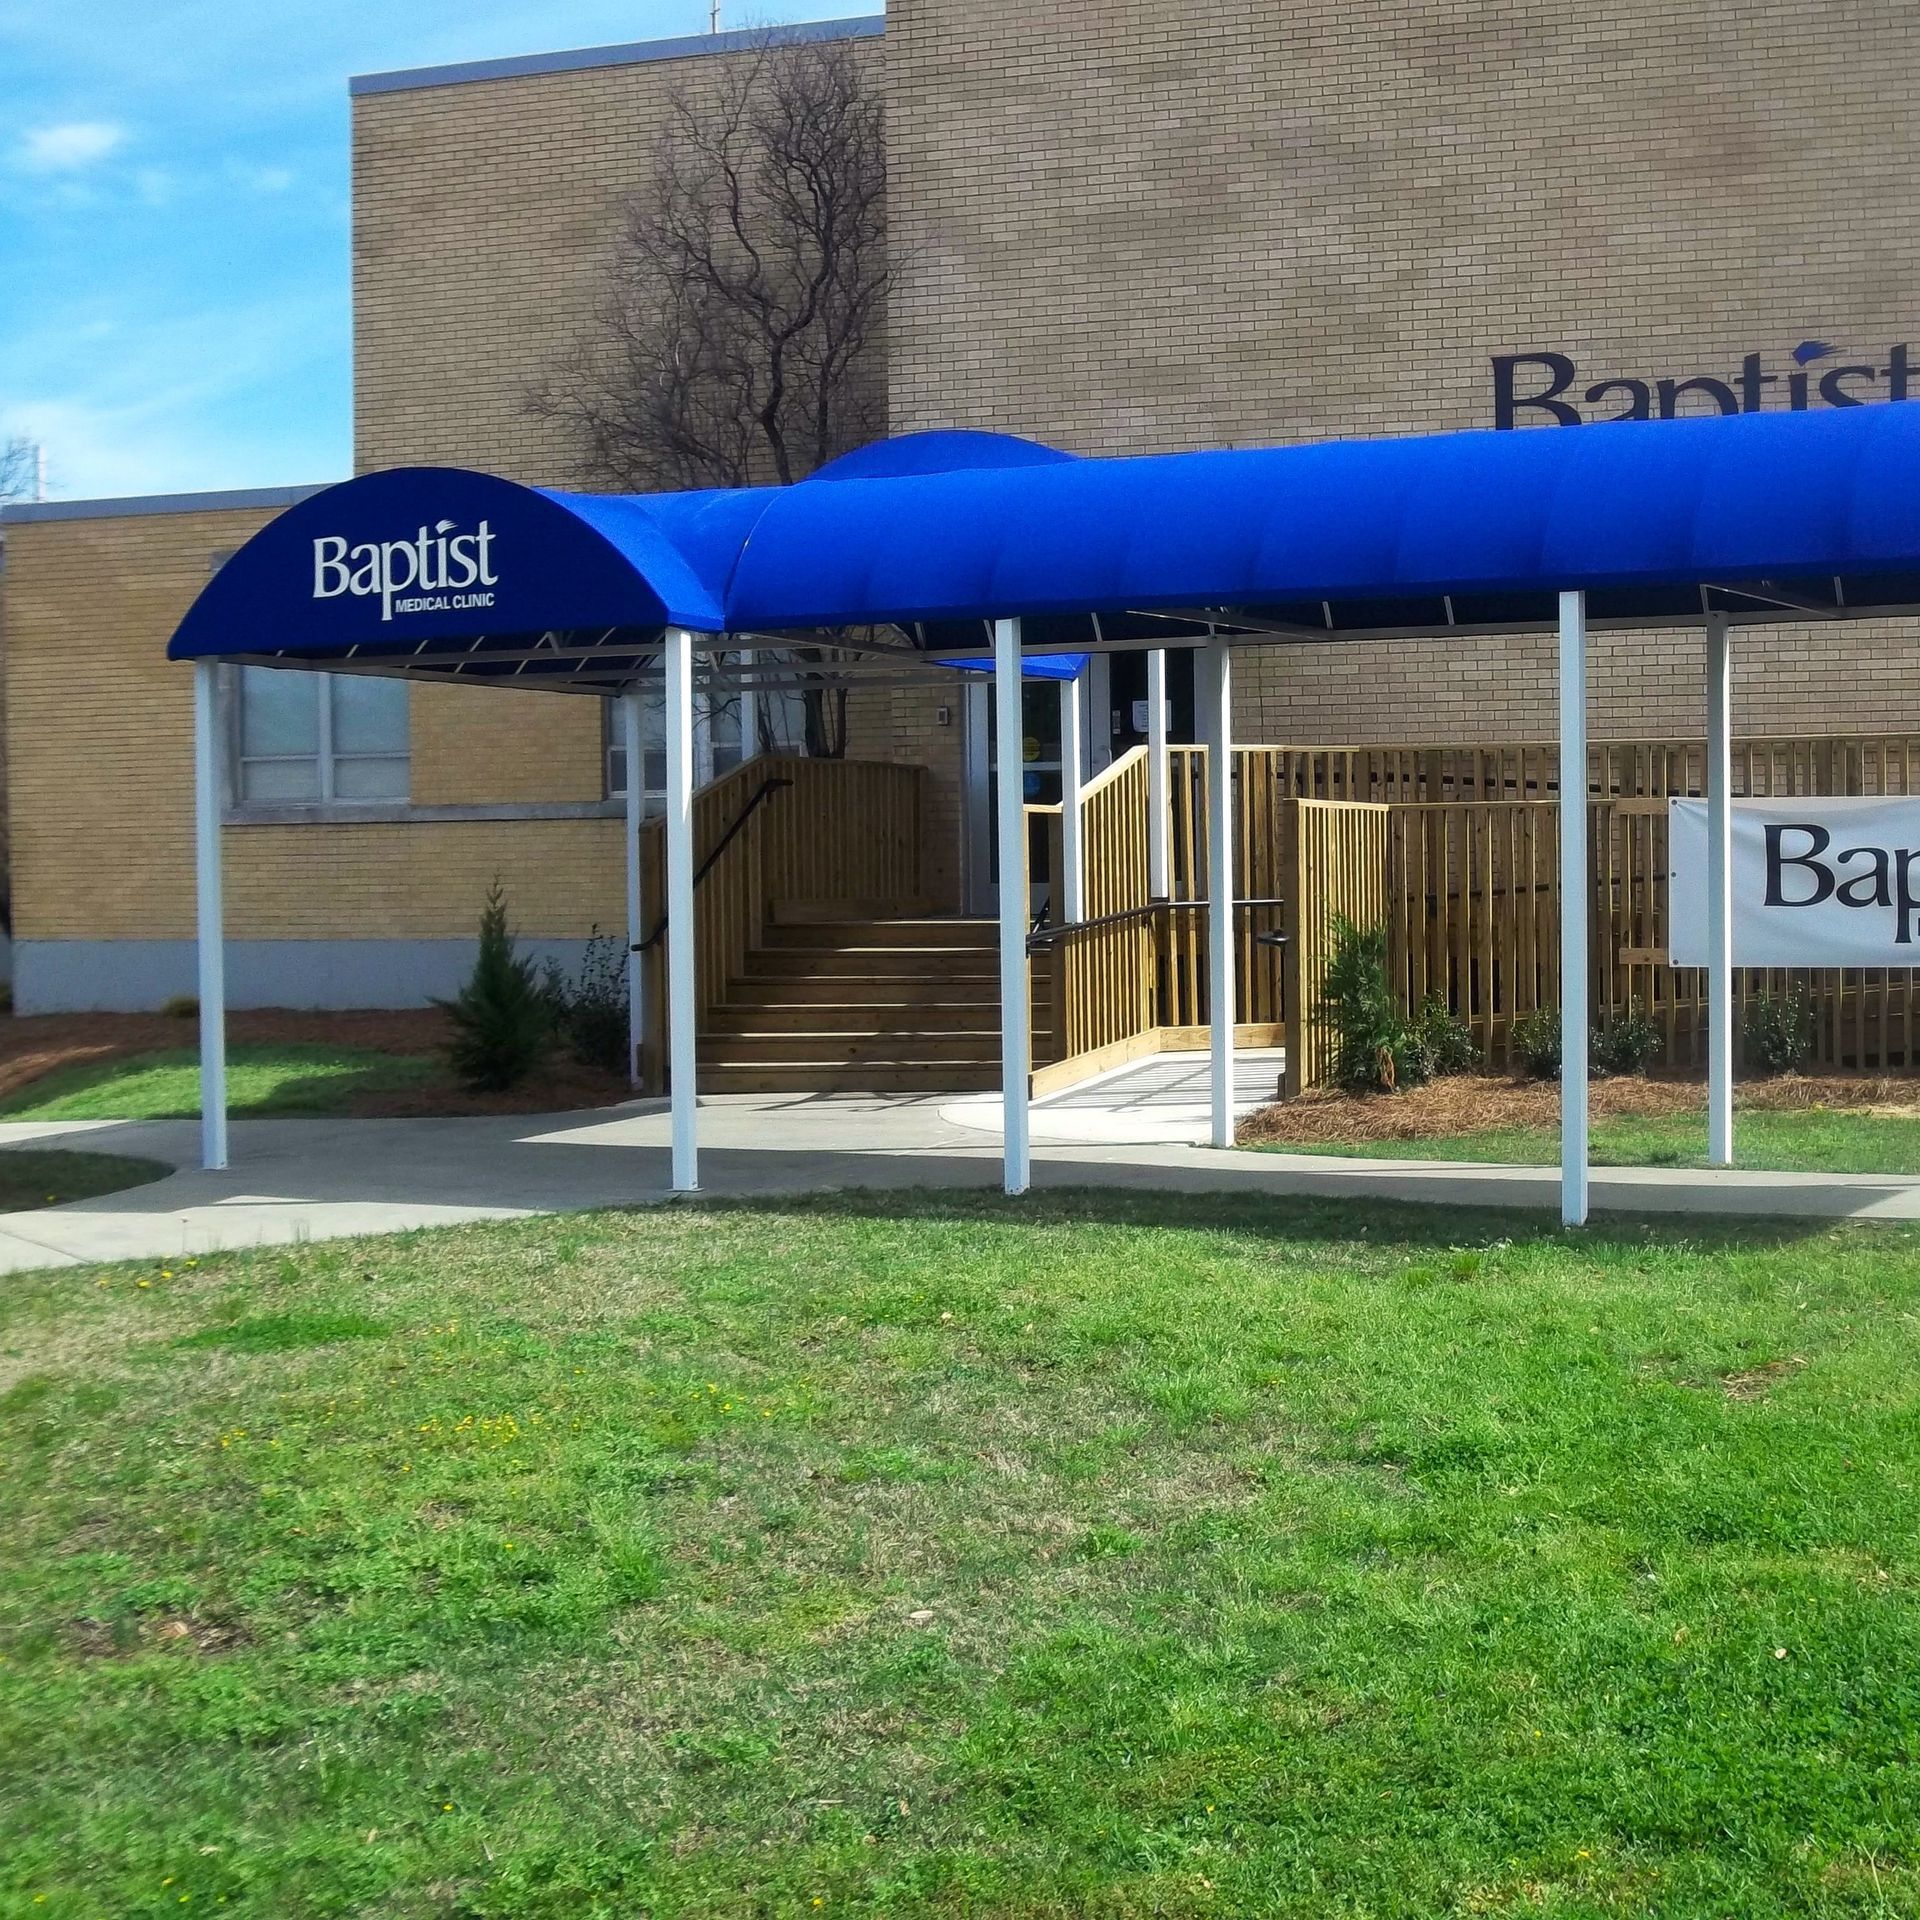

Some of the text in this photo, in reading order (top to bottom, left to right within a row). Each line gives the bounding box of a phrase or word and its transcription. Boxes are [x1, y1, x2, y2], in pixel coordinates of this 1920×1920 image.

[313, 519, 499, 620] Baptist
[395, 593, 495, 613] MEDICAL CLINIC
